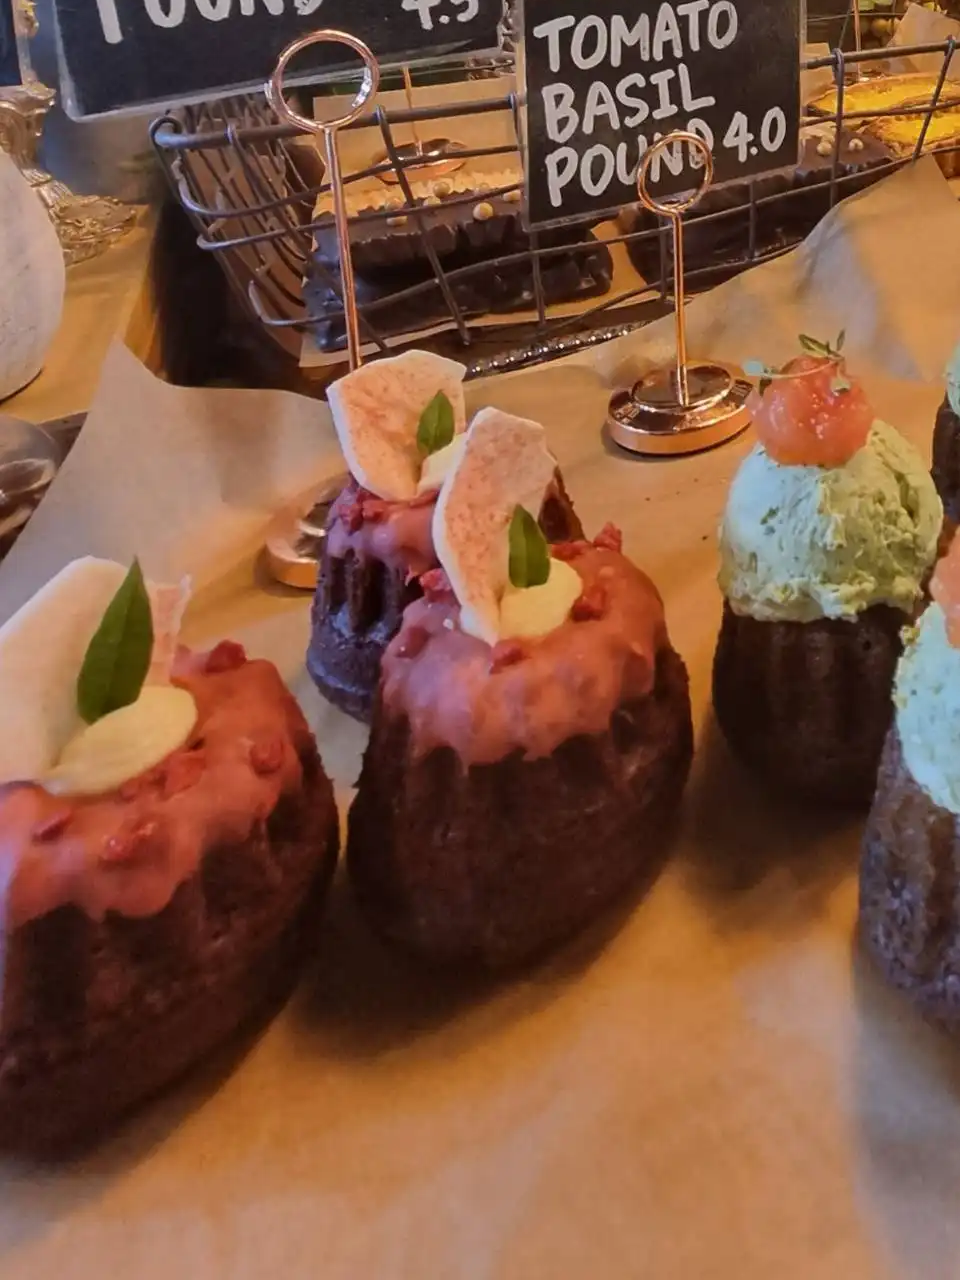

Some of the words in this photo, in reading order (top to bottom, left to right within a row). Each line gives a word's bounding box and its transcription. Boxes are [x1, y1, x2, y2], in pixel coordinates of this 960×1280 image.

[533, 0, 738, 73] TOMATO
[541, 63, 716, 143] BASIL
[545, 118, 714, 207] POUND
[723, 106, 787, 163] 4.0
